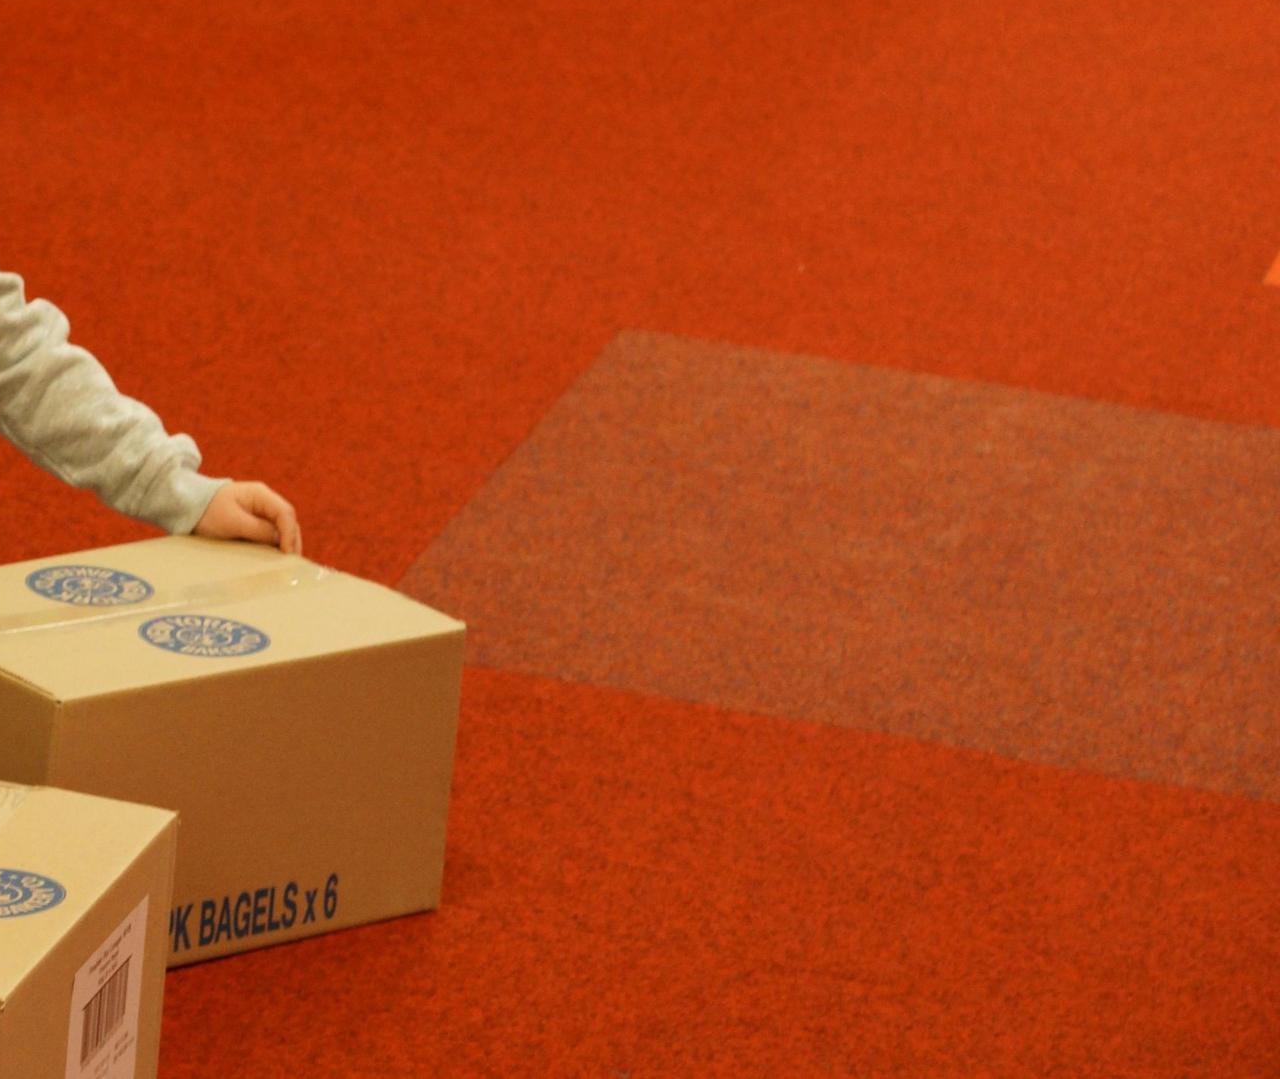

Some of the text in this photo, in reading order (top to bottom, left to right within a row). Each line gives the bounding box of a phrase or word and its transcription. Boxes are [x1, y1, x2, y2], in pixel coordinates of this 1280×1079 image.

[198, 882, 299, 947] BAGELS
[302, 887, 319, 925] x
[323, 873, 339, 920] 6
